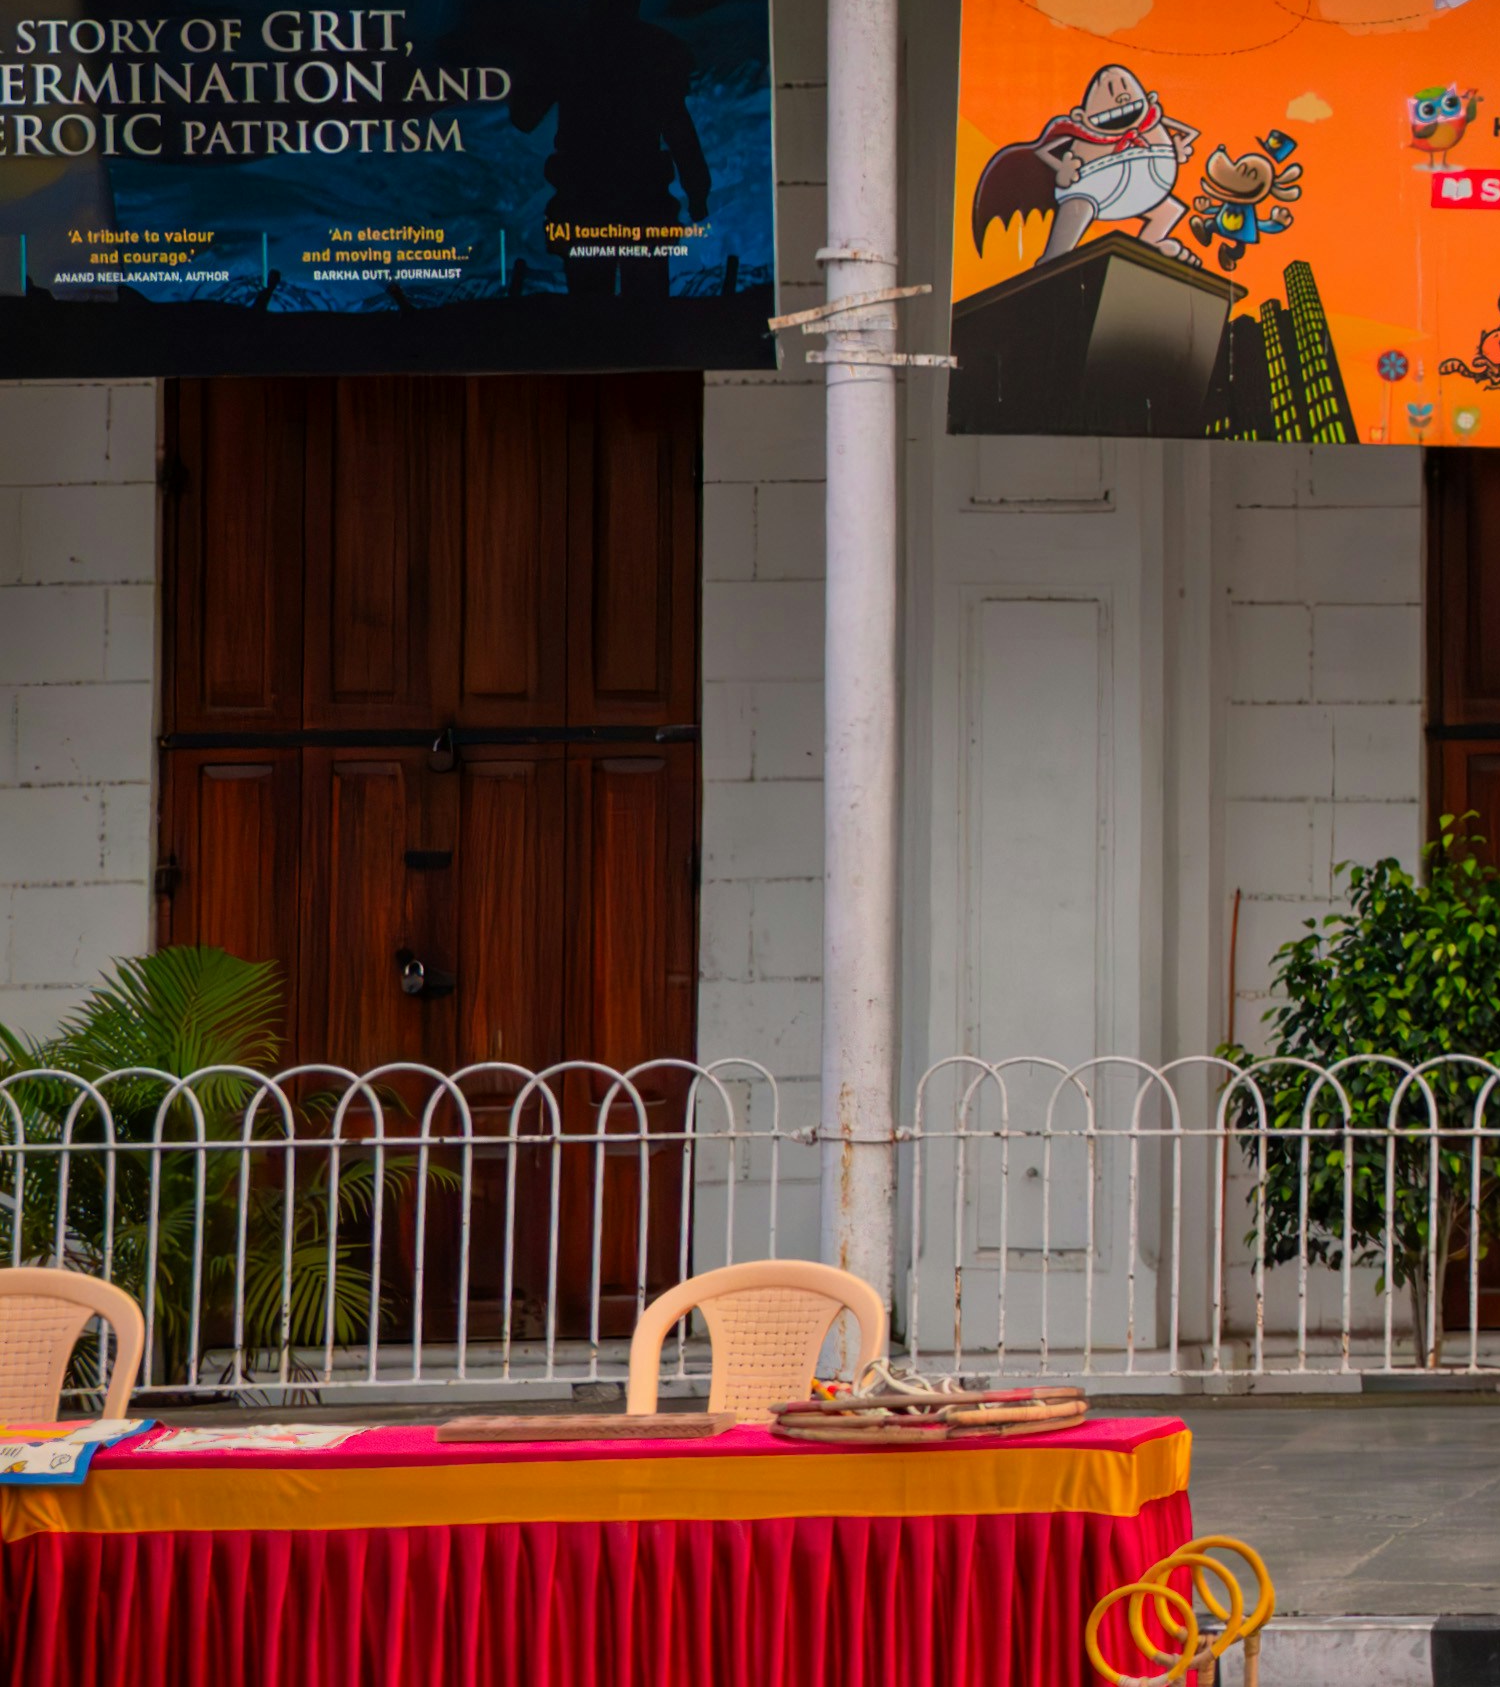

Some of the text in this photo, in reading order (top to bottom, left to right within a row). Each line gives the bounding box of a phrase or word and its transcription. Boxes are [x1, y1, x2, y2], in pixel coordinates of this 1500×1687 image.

[16, 9, 413, 57] STORY OF GRIT,
[402, 67, 512, 101] AND
[0, 113, 466, 156] ROIC PATRIOTISM
[87, 229, 140, 244] tribute
[144, 229, 160, 243] to
[164, 228, 215, 243] valour
[357, 226, 445, 243] electrifying
[575, 224, 641, 241] touching
[90, 249, 196, 266] and courage.'
[302, 248, 331, 262] and
[335, 247, 392, 264] moving
[569, 246, 688, 258] ANUPAM KHER, ACTOR
[54, 270, 230, 283] ANAND NEELAKANTAN, AUTHOR
[313, 268, 462, 281] BARKHA DUTT, JOURNALIST
